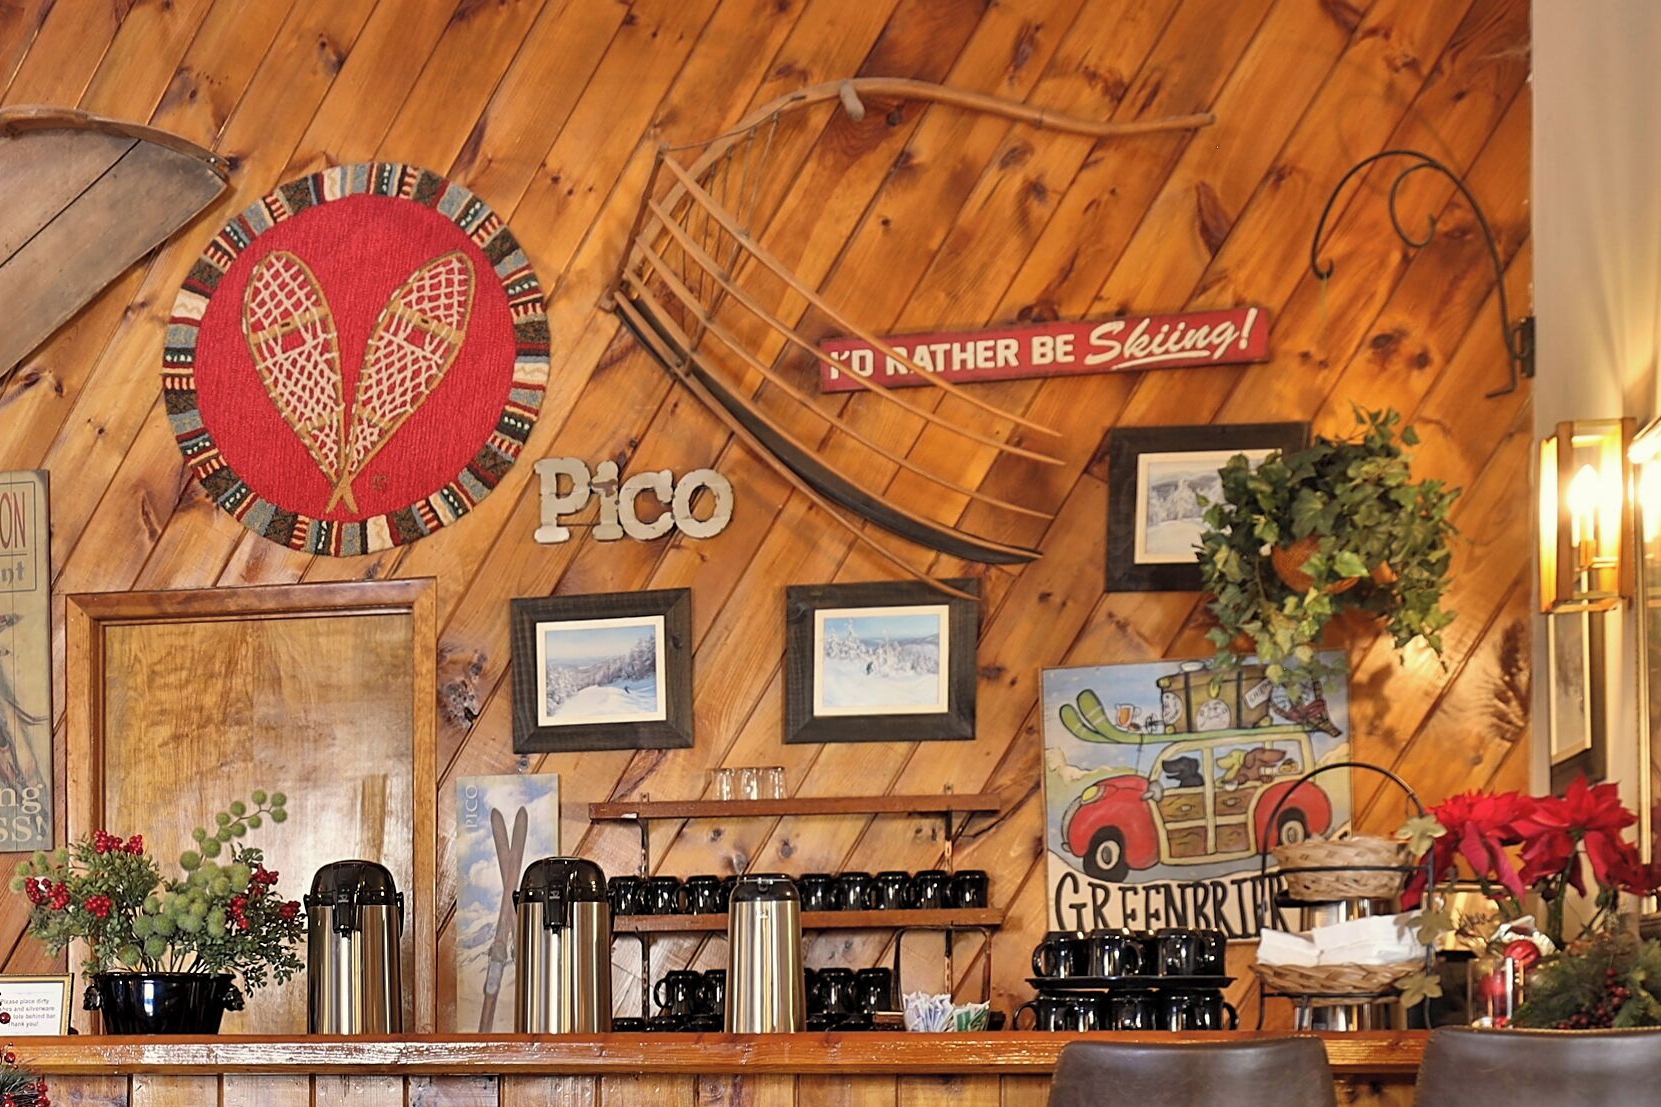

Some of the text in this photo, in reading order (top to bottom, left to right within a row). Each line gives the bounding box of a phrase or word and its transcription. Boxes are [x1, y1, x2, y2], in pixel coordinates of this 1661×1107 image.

[829, 306, 1259, 380] I'D RATHER BE Skiing!
[465, 784, 478, 829] PICO
